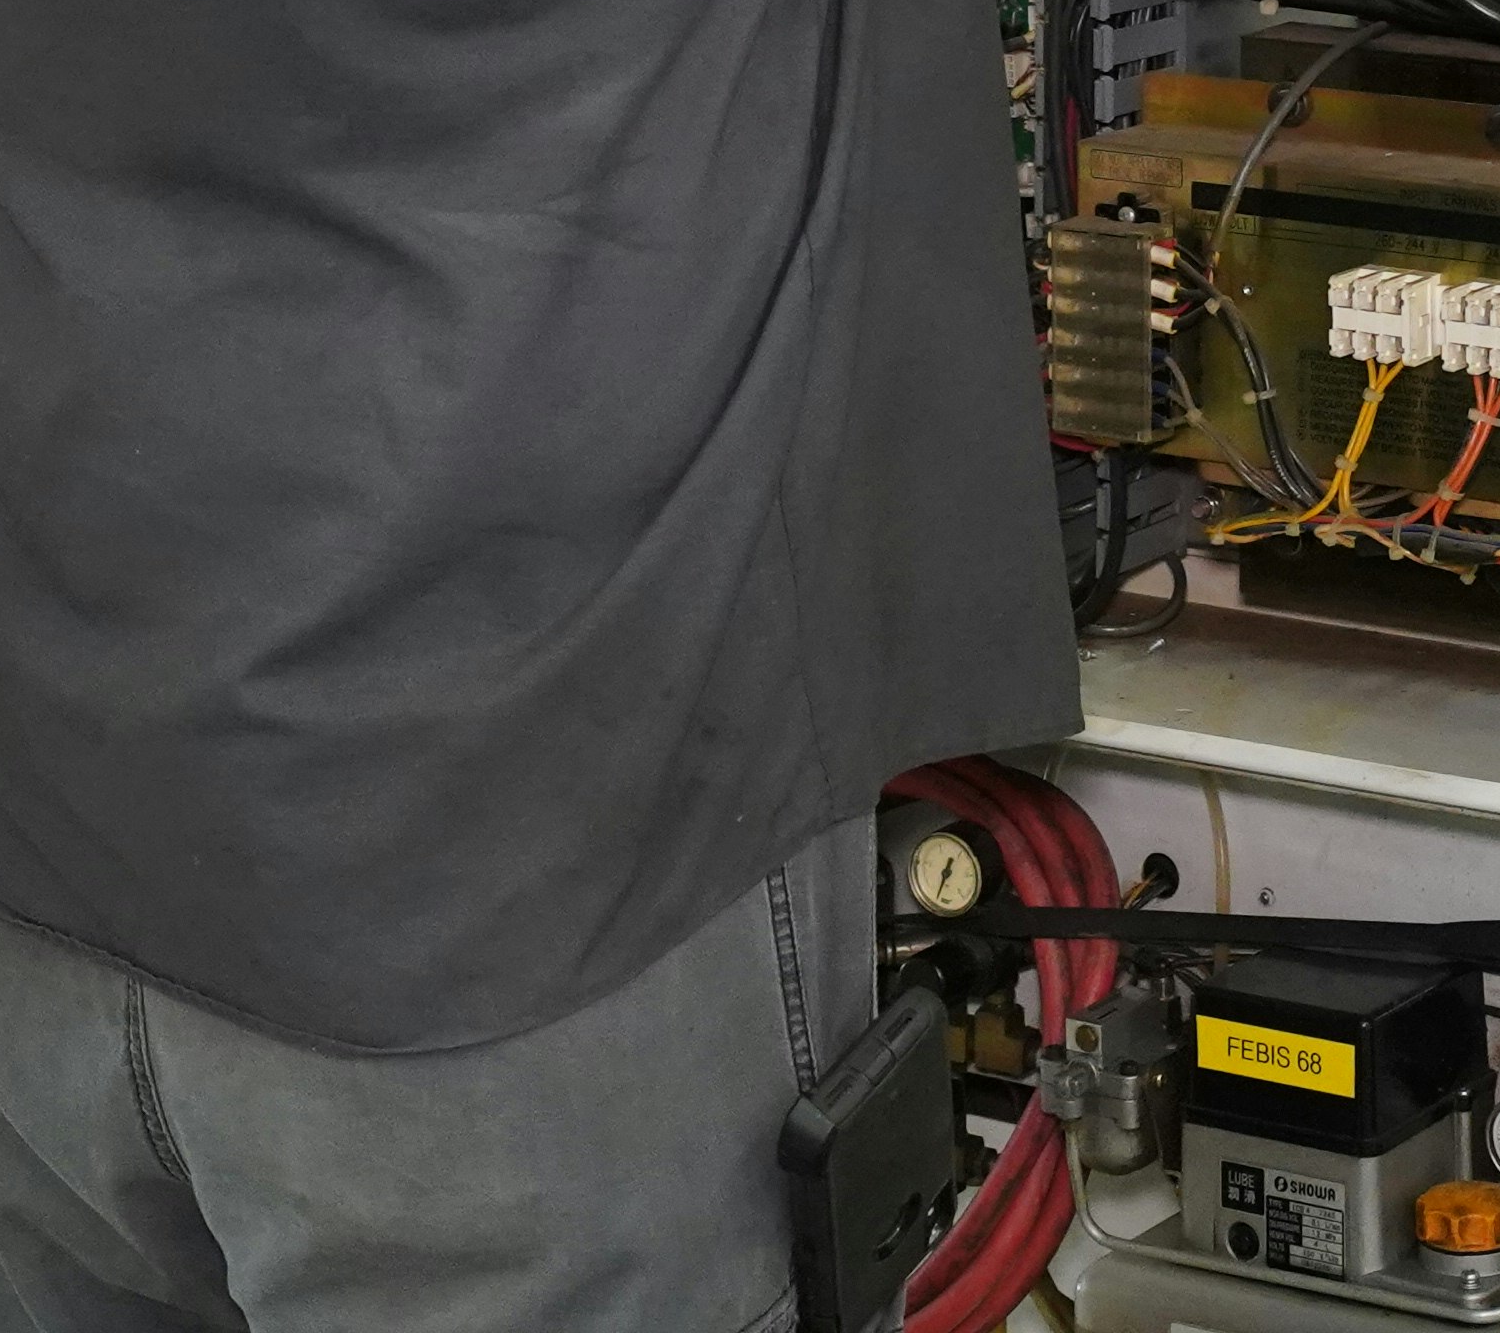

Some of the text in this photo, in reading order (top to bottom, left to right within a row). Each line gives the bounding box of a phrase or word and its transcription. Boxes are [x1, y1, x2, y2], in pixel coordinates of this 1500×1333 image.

[1227, 1036, 1323, 1076] FEBIS 68
[1228, 1170, 1255, 1188] LUBE
[1290, 1181, 1336, 1202] SHOWA
